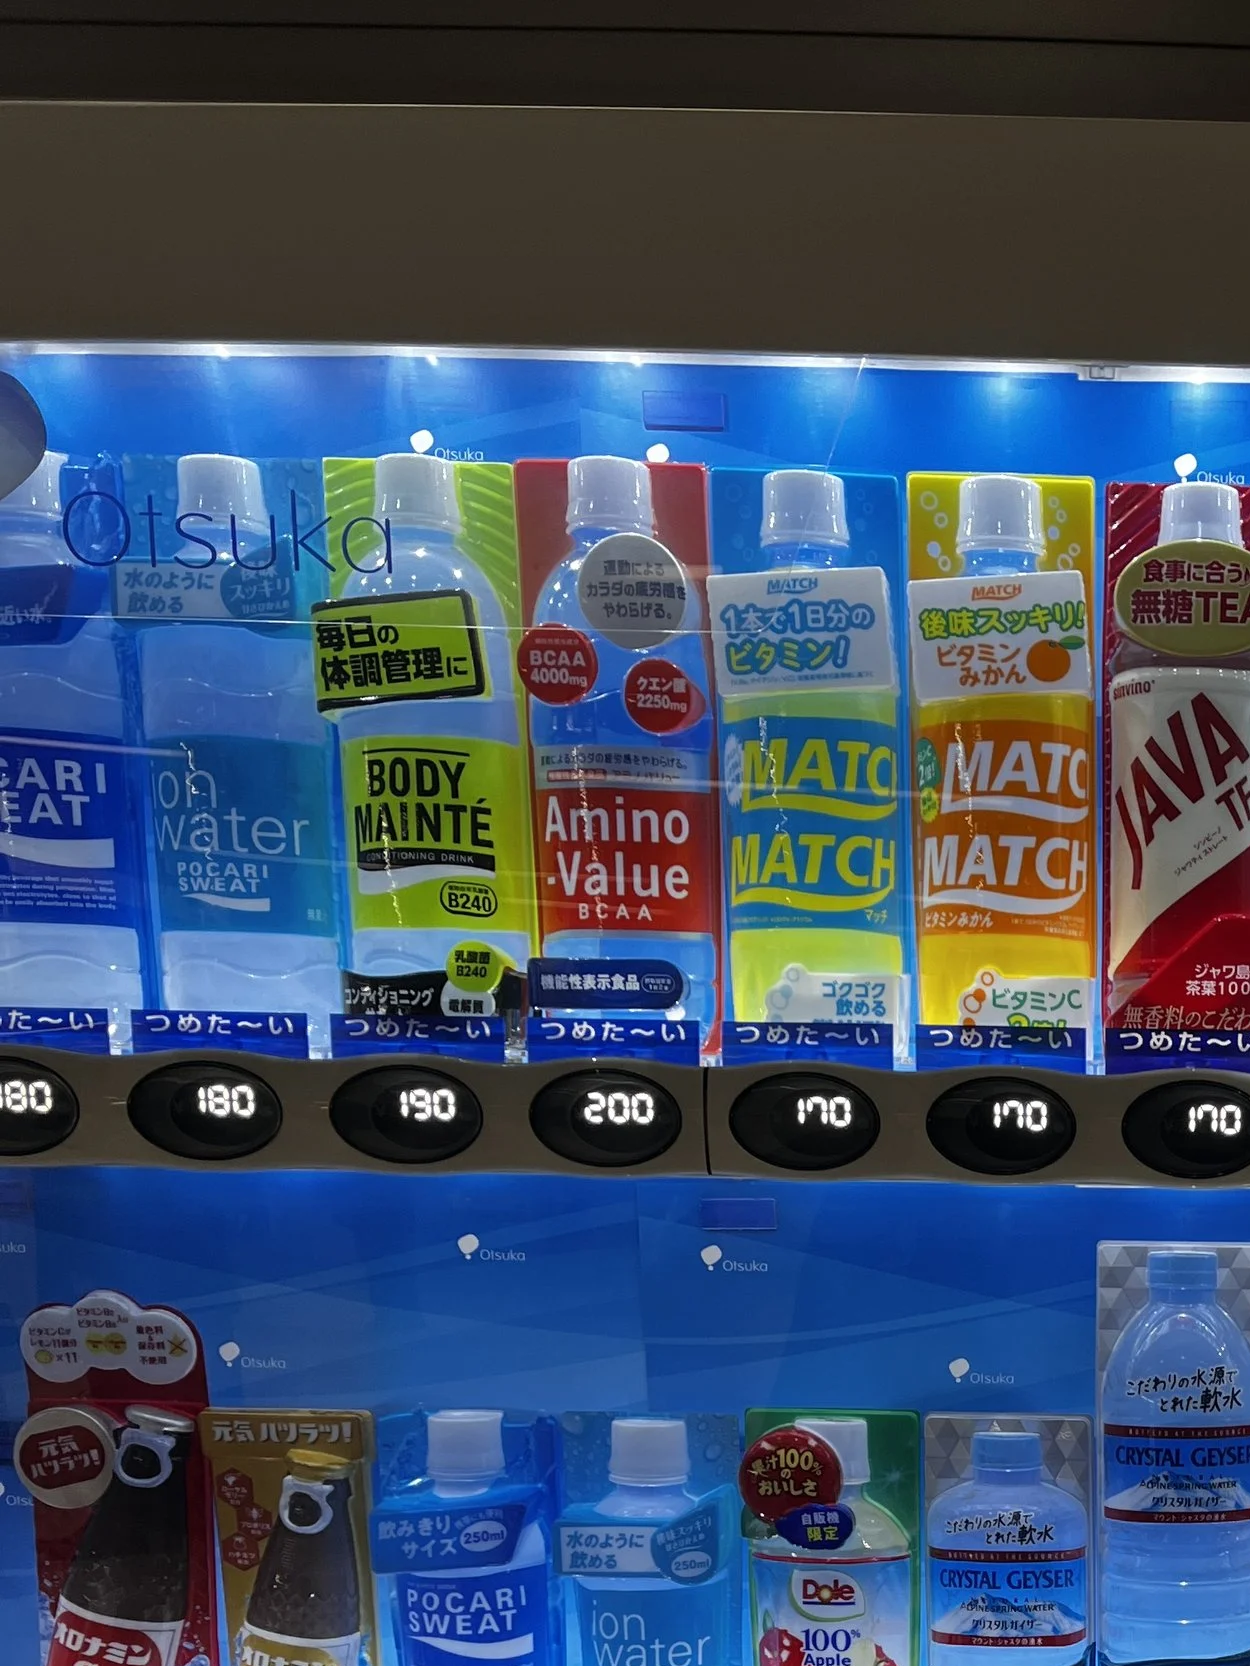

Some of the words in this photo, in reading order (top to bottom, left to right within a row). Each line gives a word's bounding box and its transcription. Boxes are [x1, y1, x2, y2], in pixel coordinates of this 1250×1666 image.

[434, 446, 485, 461] Otsuka
[1196, 471, 1246, 485] Otsuka
[62, 488, 394, 573] Otsuka
[767, 577, 818, 594] MATCH
[127, 592, 184, 613] 飲める
[723, 601, 874, 637] 1本で1日分の
[315, 614, 399, 655] 毎日の
[529, 649, 586, 677] BCAA
[936, 645, 1021, 665] ビタミン
[319, 646, 469, 692] 体調管理に
[530, 668, 588, 688] 4000mg
[959, 665, 1028, 687] みかん
[636, 676, 687, 694] クエン酸
[636, 694, 688, 713] 2250mg
[366, 758, 467, 798] BODY
[355, 798, 495, 850] MAINTÉ
[545, 796, 690, 844] Amino
[177, 861, 269, 879] POCARI
[179, 877, 261, 893] SWEAT
[578, 902, 653, 922] BCAA
[924, 912, 994, 928] ビタミンみかん
[456, 964, 488, 979] B240
[540, 972, 640, 992] 機能性表示食品
[822, 982, 886, 998] ゴクゴク
[836, 999, 887, 1017] 飲める
[197, 1083, 256, 1118] 180
[399, 1088, 456, 1122] 190
[583, 1092, 655, 1124] 200
[992, 1099, 1048, 1133] 170
[1187, 1104, 1242, 1136] 170
[479, 1248, 526, 1262] Otsuka
[1126, 1365, 1239, 1397] こだわりの水源で
[1114, 1444, 1183, 1468] CRYSTAL
[757, 1476, 818, 1498] おいしさ
[800, 1510, 840, 1526] 自販機
[378, 1518, 452, 1541] 飲みきり
[463, 1529, 506, 1544] 250ml
[566, 1530, 645, 1550] 水のように
[807, 1524, 840, 1541] 限定
[569, 1550, 617, 1569] 飲める
[801, 1577, 856, 1601] Dole
[939, 1569, 1001, 1591] CRYSTAL
[1006, 1568, 1075, 1590] GEYSER
[406, 1584, 528, 1609] POCARI
[408, 1608, 518, 1635] SWEAT
[971, 1617, 1044, 1631] クリスタルガイザー
[54, 1621, 152, 1666] オロナミン
[802, 1626, 861, 1653] 100%
